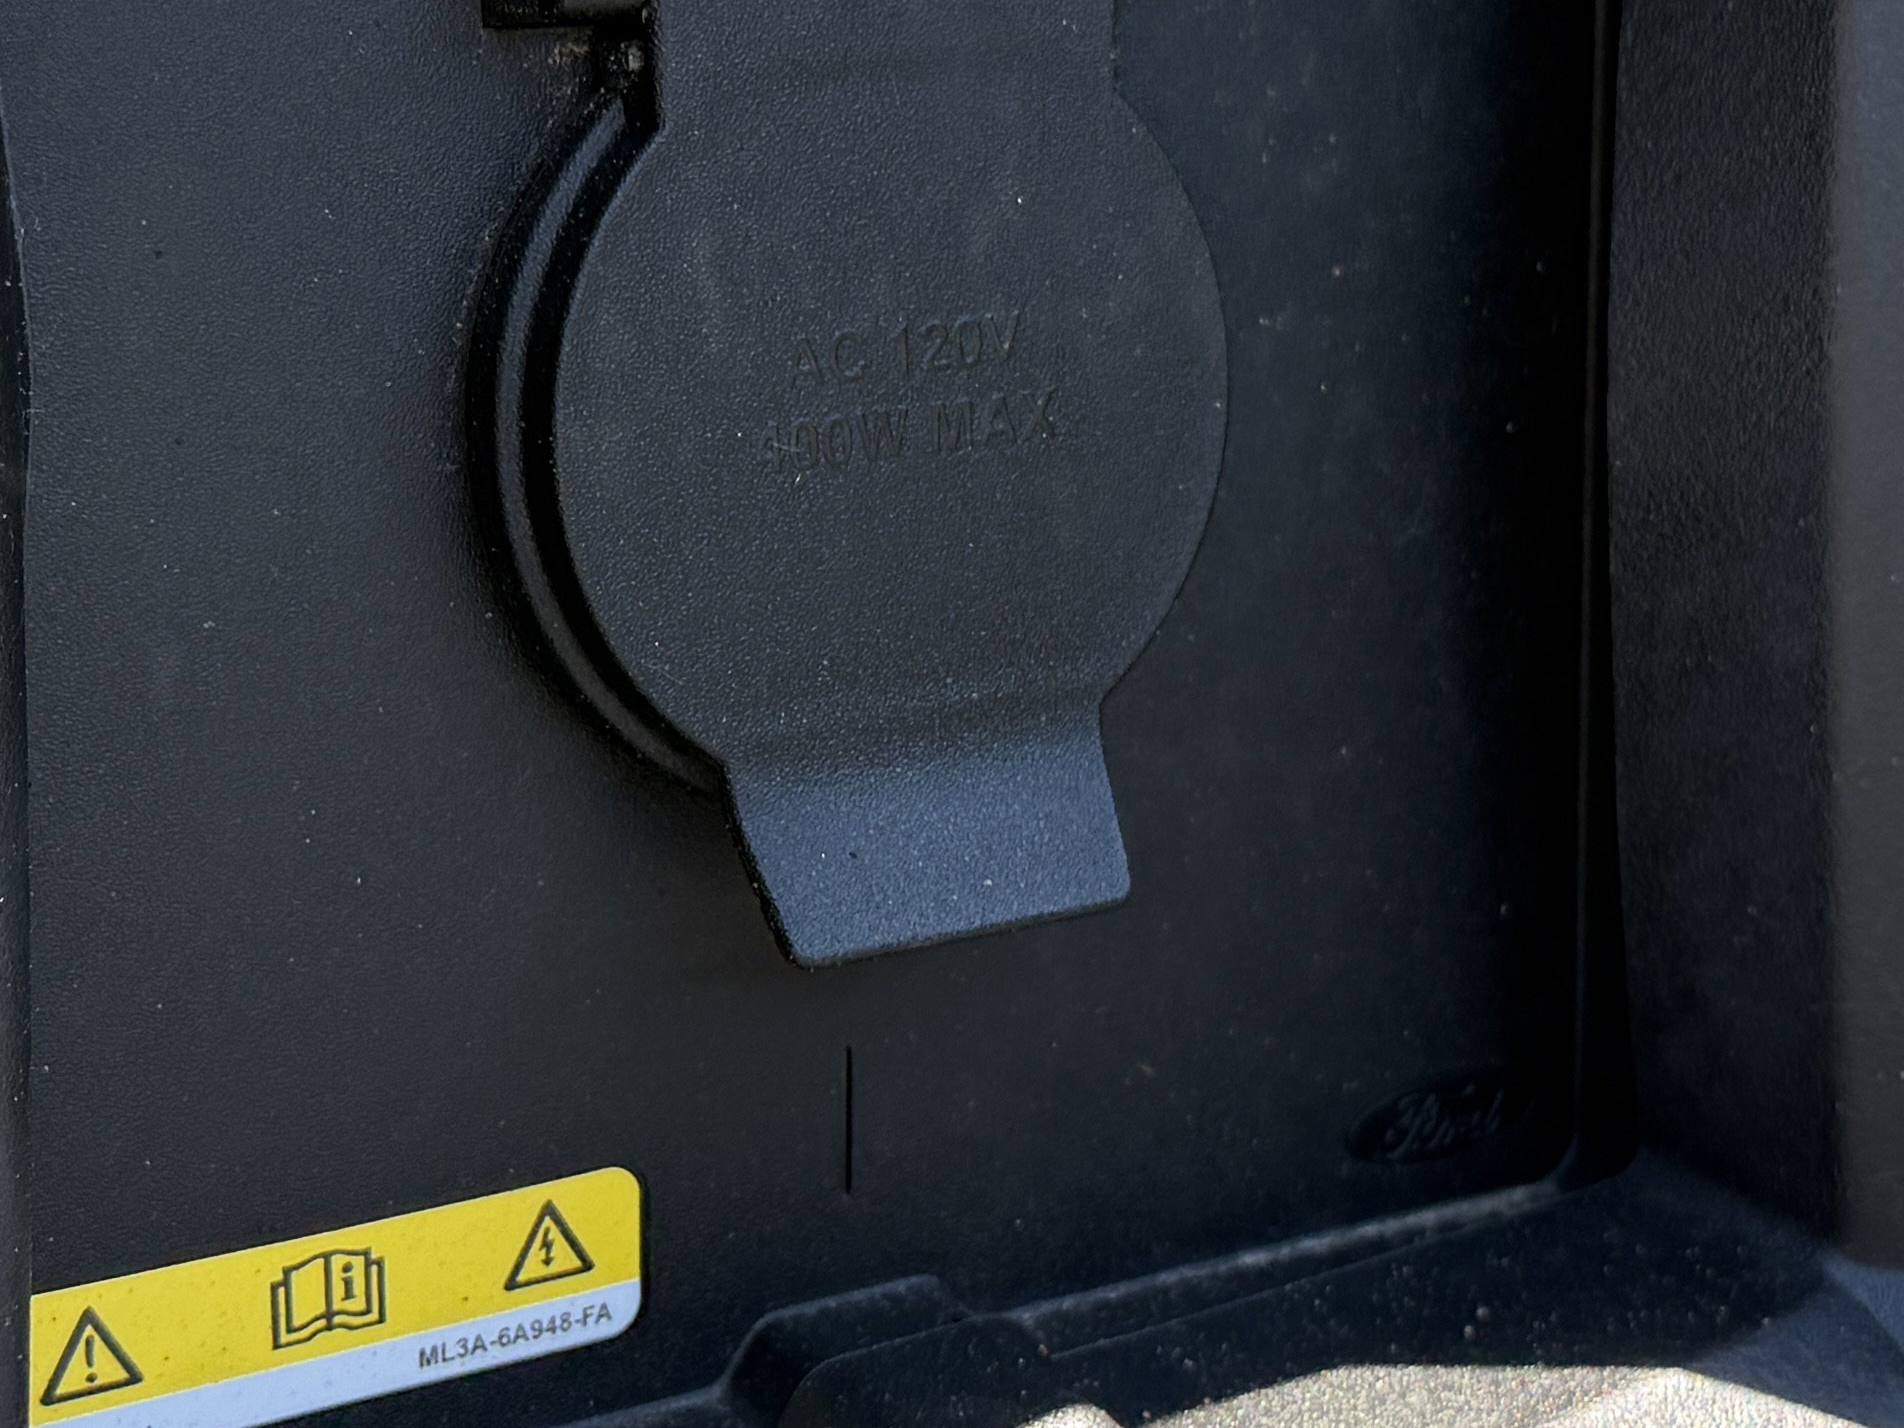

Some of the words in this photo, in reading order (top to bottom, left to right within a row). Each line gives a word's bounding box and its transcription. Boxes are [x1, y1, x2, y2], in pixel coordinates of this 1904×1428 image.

[791, 330, 869, 387] AC
[889, 309, 1022, 378] 120V
[930, 386, 1059, 454] MAX
[418, 1301, 613, 1369] ML3A-6A948-FA
